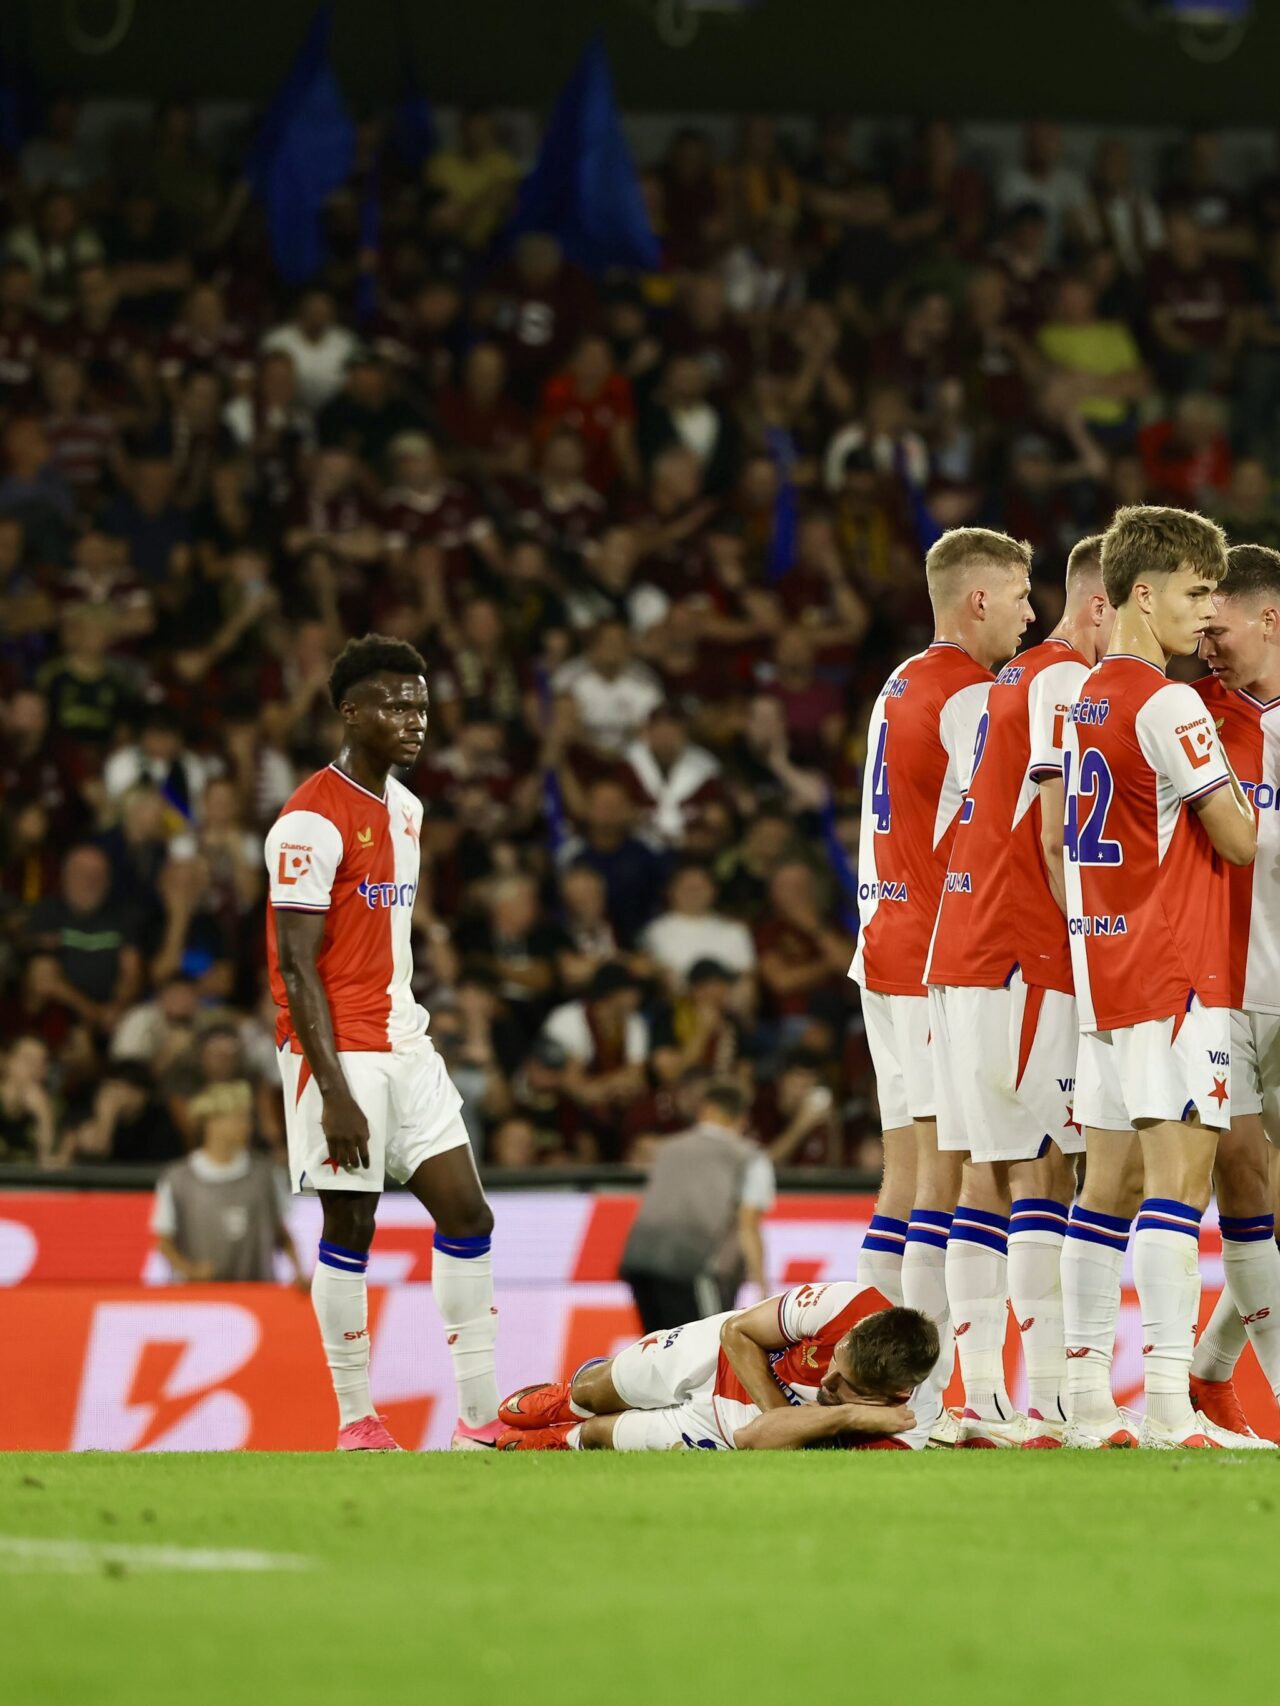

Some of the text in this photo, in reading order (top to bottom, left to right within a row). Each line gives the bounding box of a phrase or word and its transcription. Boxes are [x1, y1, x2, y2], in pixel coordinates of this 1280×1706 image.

[1067, 697, 1110, 726] EČNÝ
[1174, 717, 1208, 735] Chance
[871, 718, 892, 833] 4
[279, 841, 313, 852] Chance
[1206, 1050, 1230, 1066] VISA
[343, 1328, 369, 1341] SK
